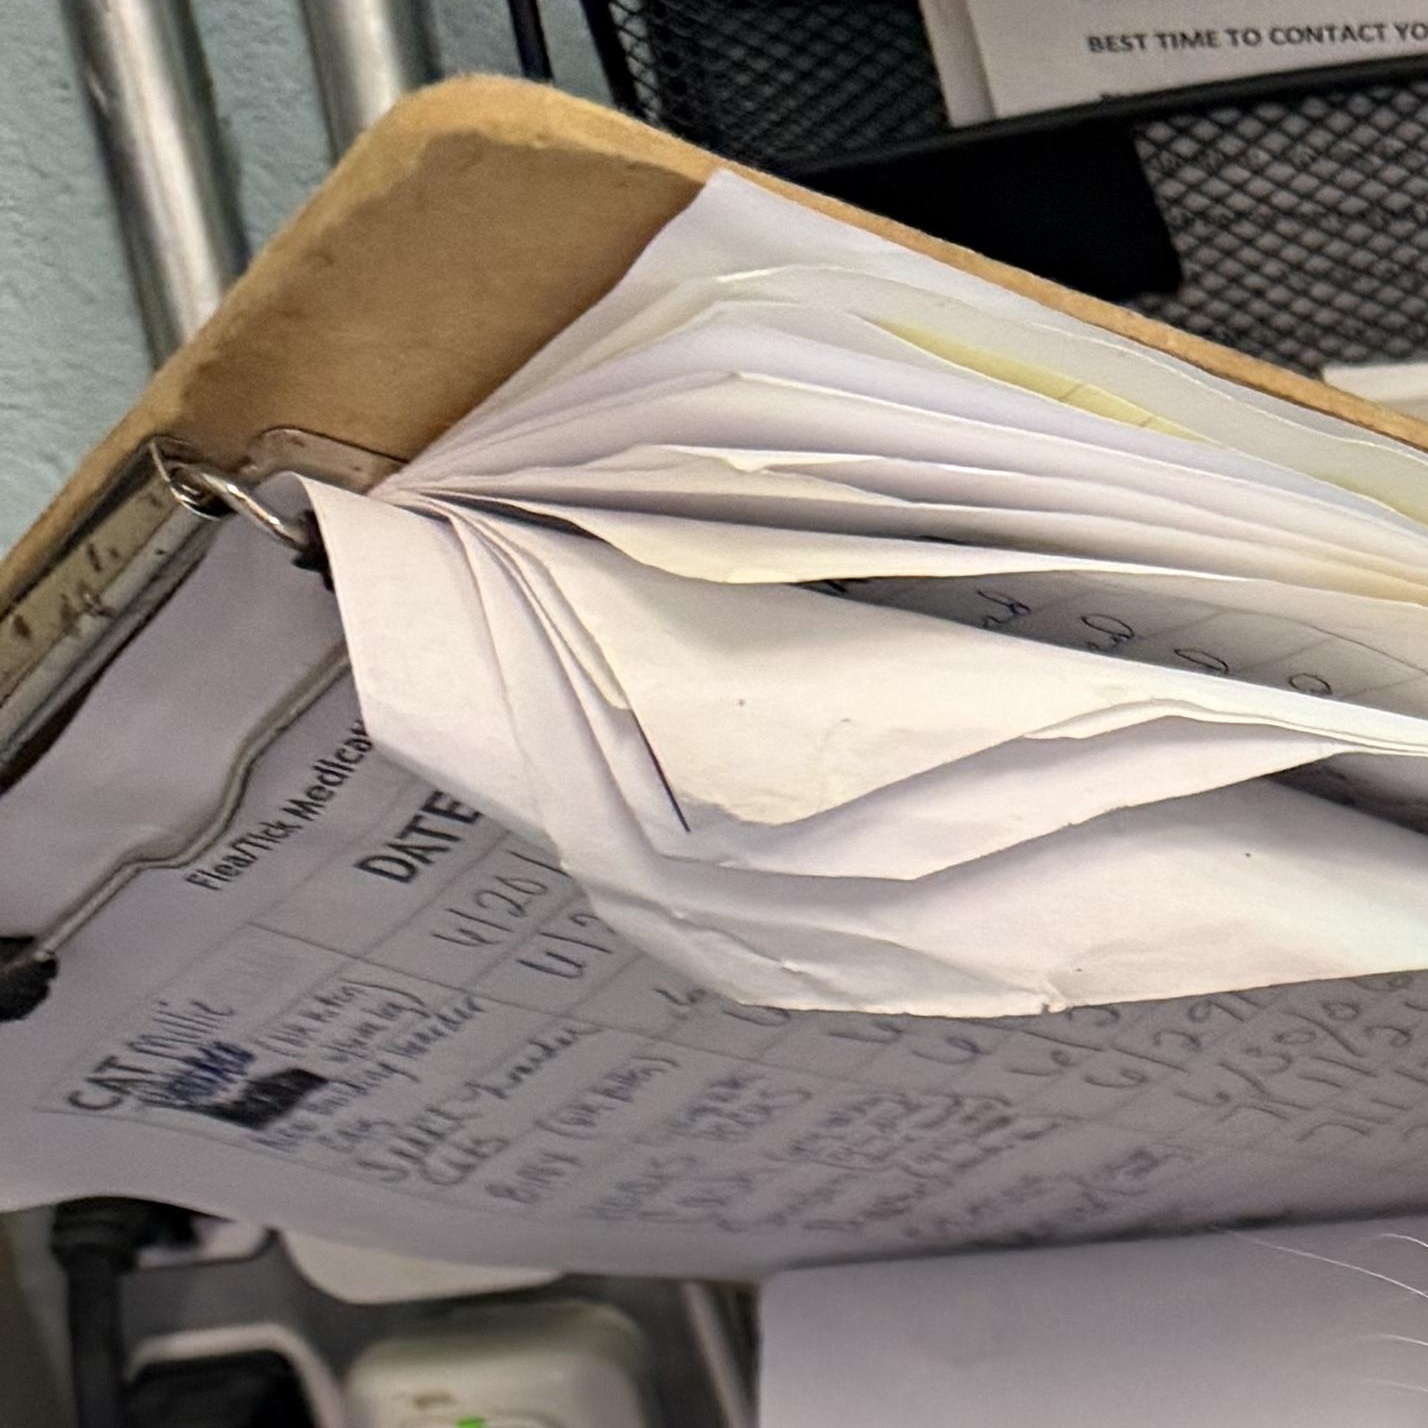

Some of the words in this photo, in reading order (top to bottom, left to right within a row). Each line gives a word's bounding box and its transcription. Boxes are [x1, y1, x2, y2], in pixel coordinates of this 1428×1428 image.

[1087, 32, 1147, 53] BEST
[1153, 29, 1219, 50] TIME
[1225, 27, 1263, 47] TO
[1268, 22, 1387, 45] CONTACT
[184, 820, 304, 891] Flea/Tick
[353, 790, 485, 884] DATE
[67, 1054, 163, 1112] CAT
